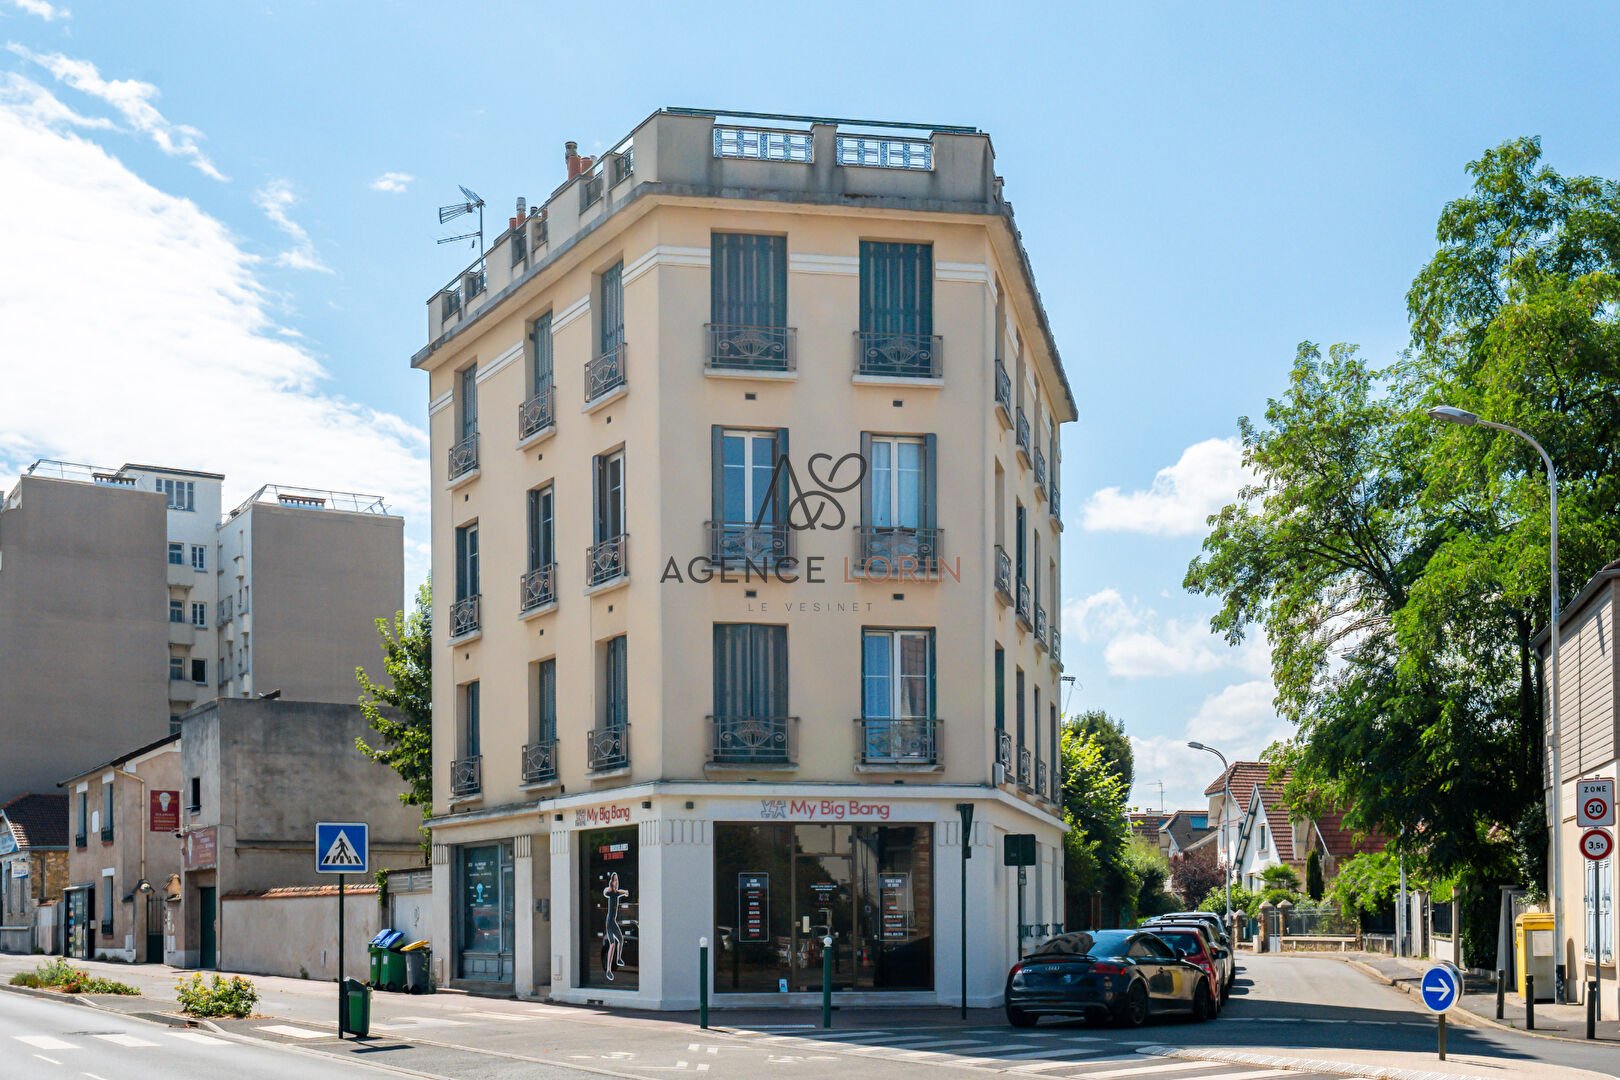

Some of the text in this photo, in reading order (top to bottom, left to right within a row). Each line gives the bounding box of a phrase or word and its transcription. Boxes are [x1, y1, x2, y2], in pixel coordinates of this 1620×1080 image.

[1583, 785, 1607, 793] ZONE
[586, 800, 631, 825] My Big Bang
[790, 799, 891, 820] My Big Bang
[1588, 804, 1603, 814] 30
[1588, 841, 1604, 850] 3,5t
